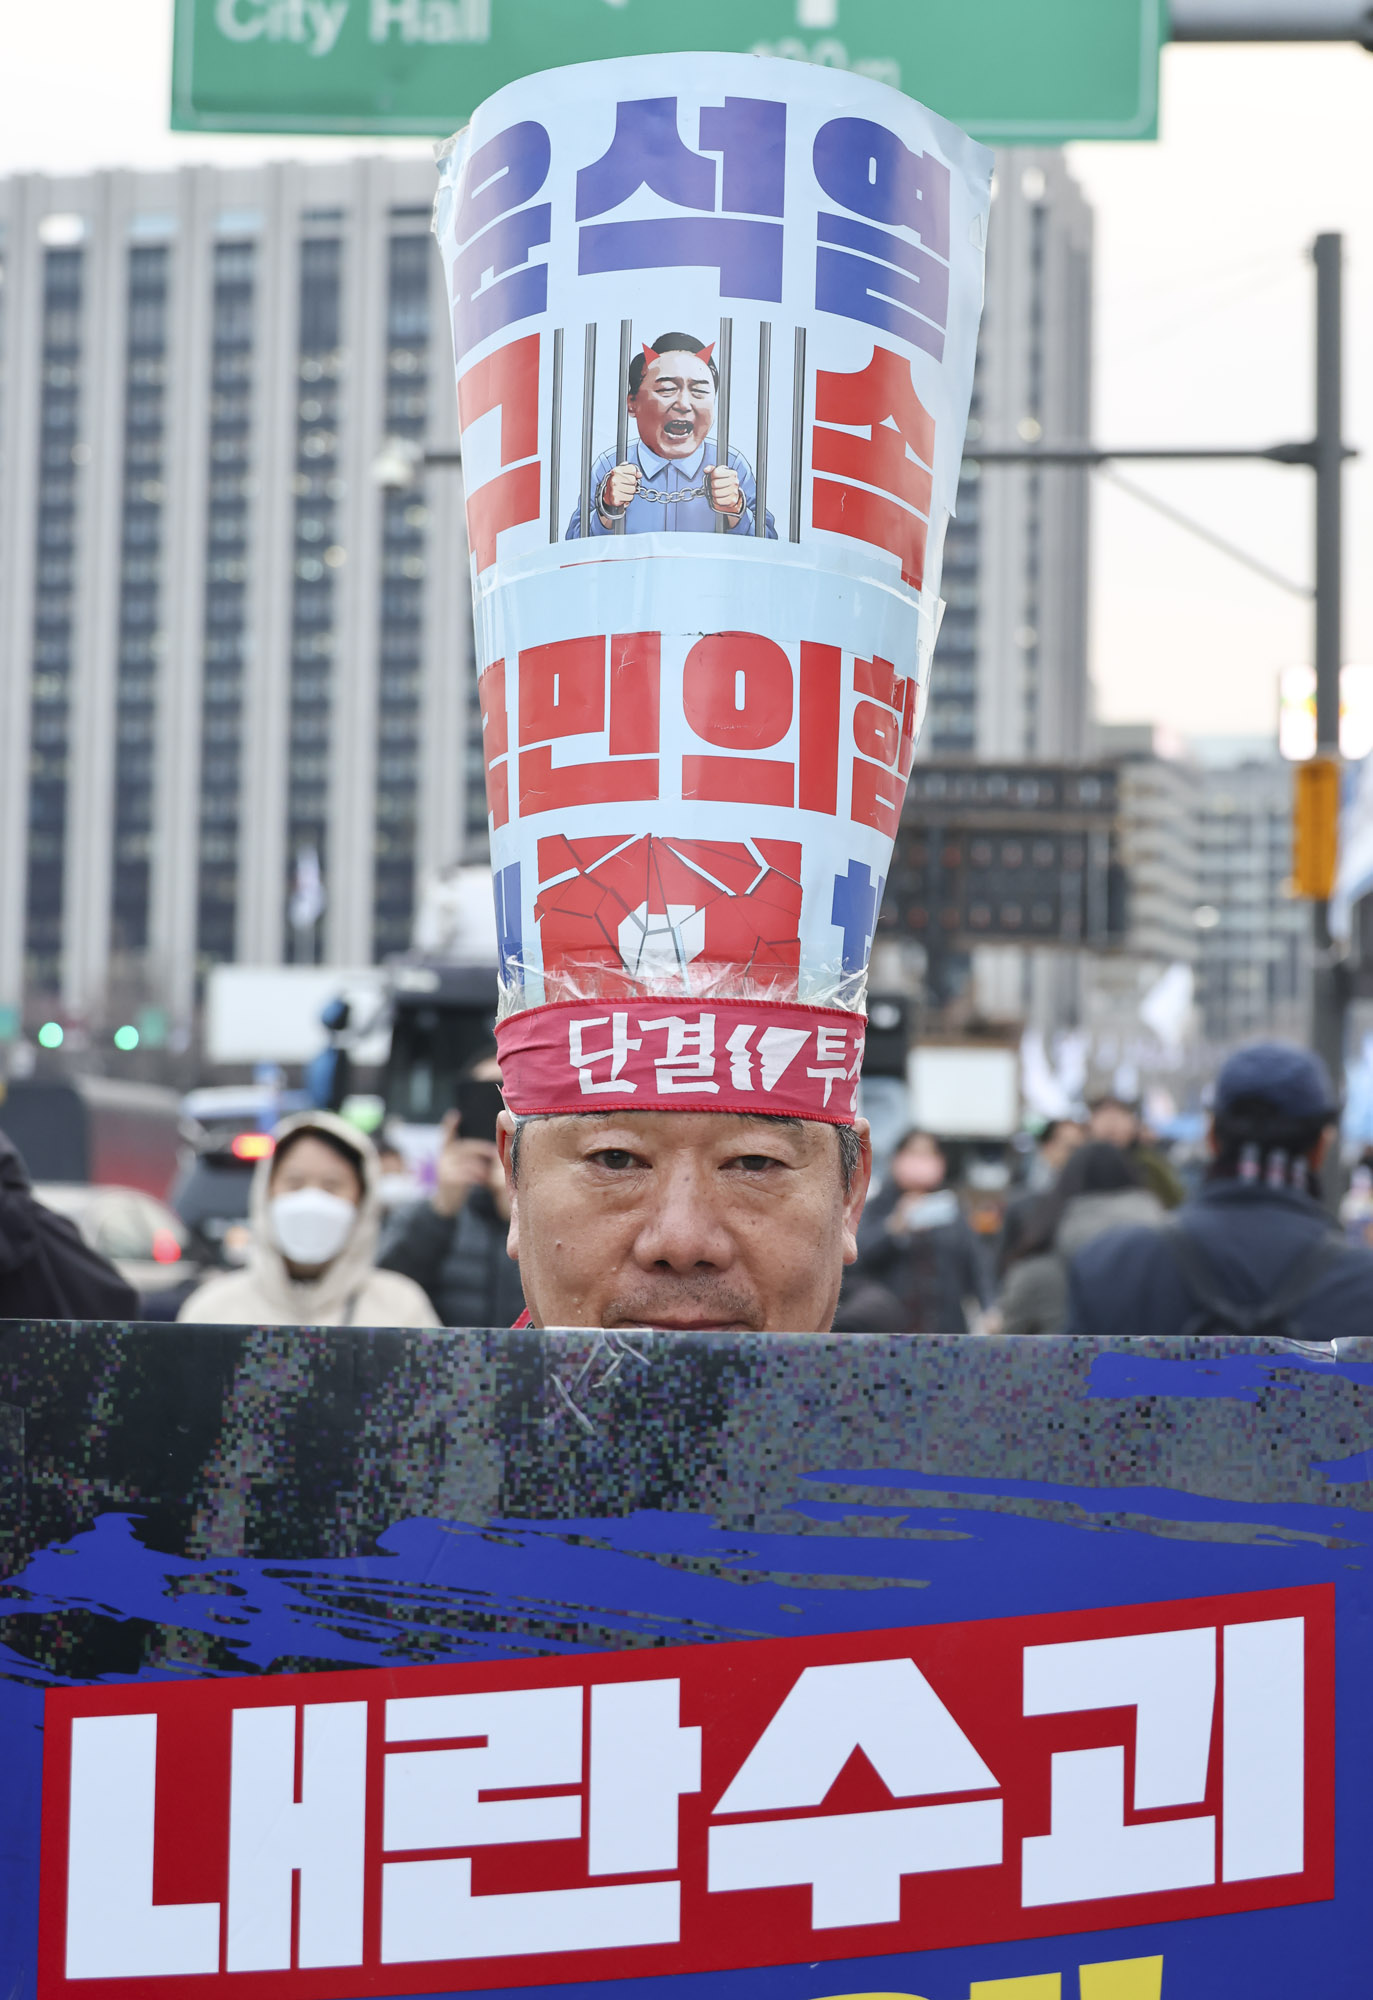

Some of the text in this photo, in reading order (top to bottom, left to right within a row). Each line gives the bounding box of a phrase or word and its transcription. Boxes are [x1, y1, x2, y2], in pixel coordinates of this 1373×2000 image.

[214, 0, 491, 56] City Hall
[453, 96, 951, 365] 윤석열
[569, 1012, 720, 1095] 단결
[65, 1616, 1304, 1980] 내란수괴
